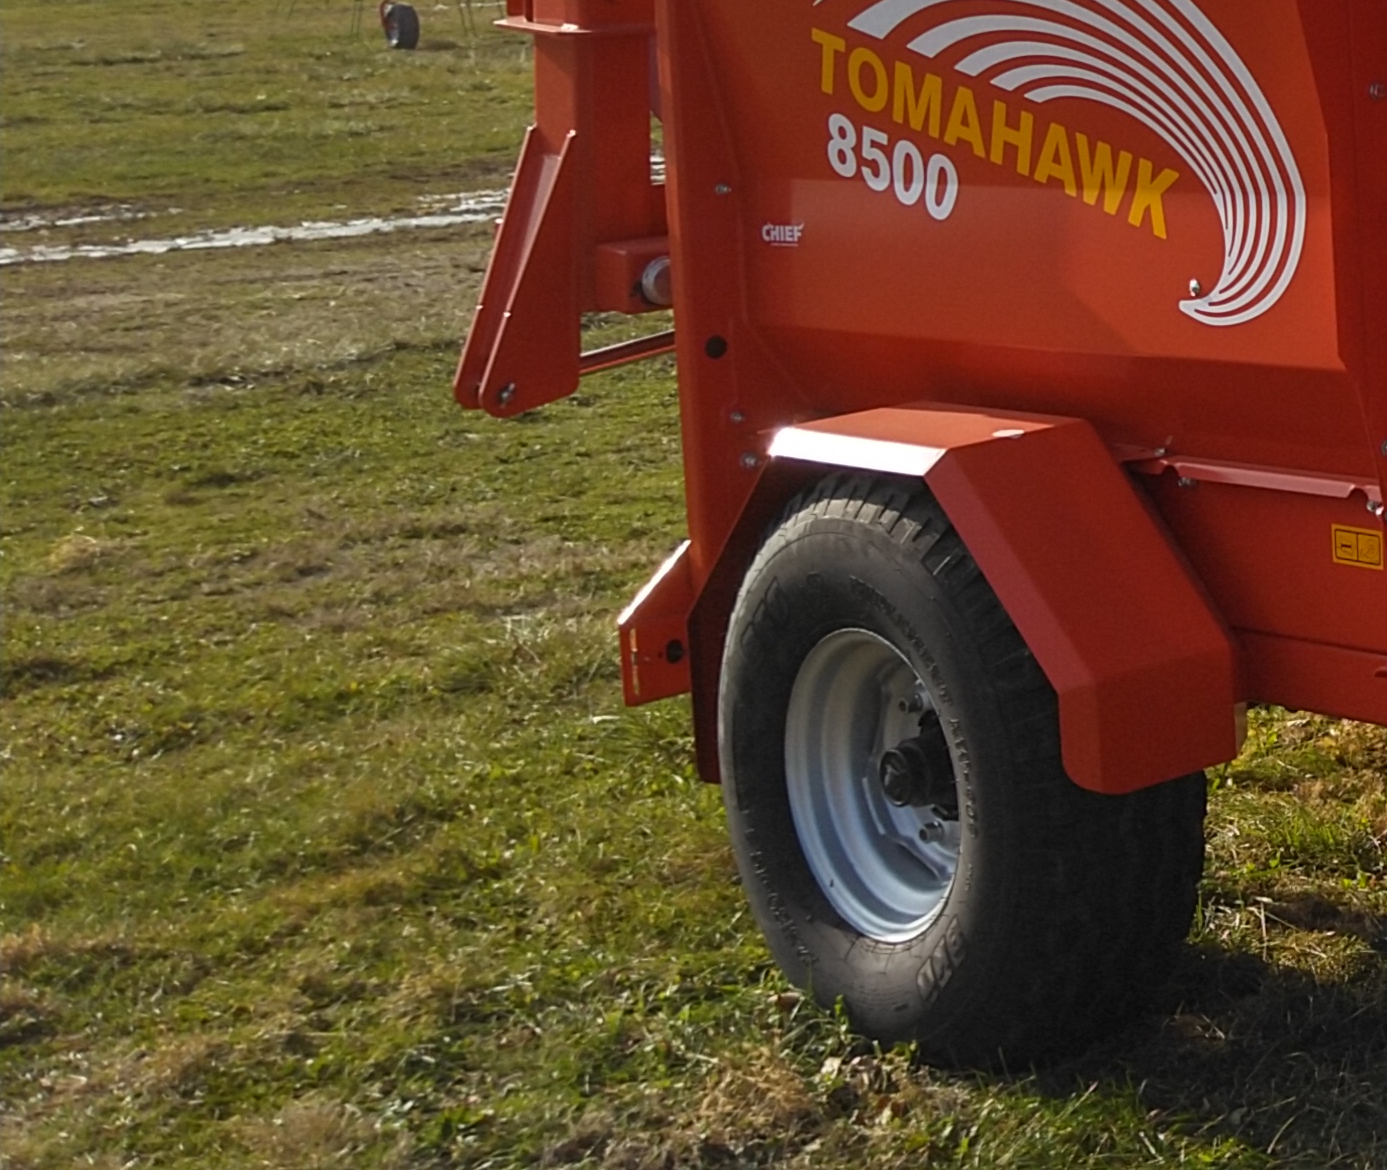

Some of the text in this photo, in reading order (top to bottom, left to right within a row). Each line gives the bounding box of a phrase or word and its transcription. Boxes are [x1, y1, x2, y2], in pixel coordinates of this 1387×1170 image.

[811, 28, 1180, 240] TOMAHAWK
[827, 113, 959, 221] 8500
[761, 221, 805, 242] CHIEF
